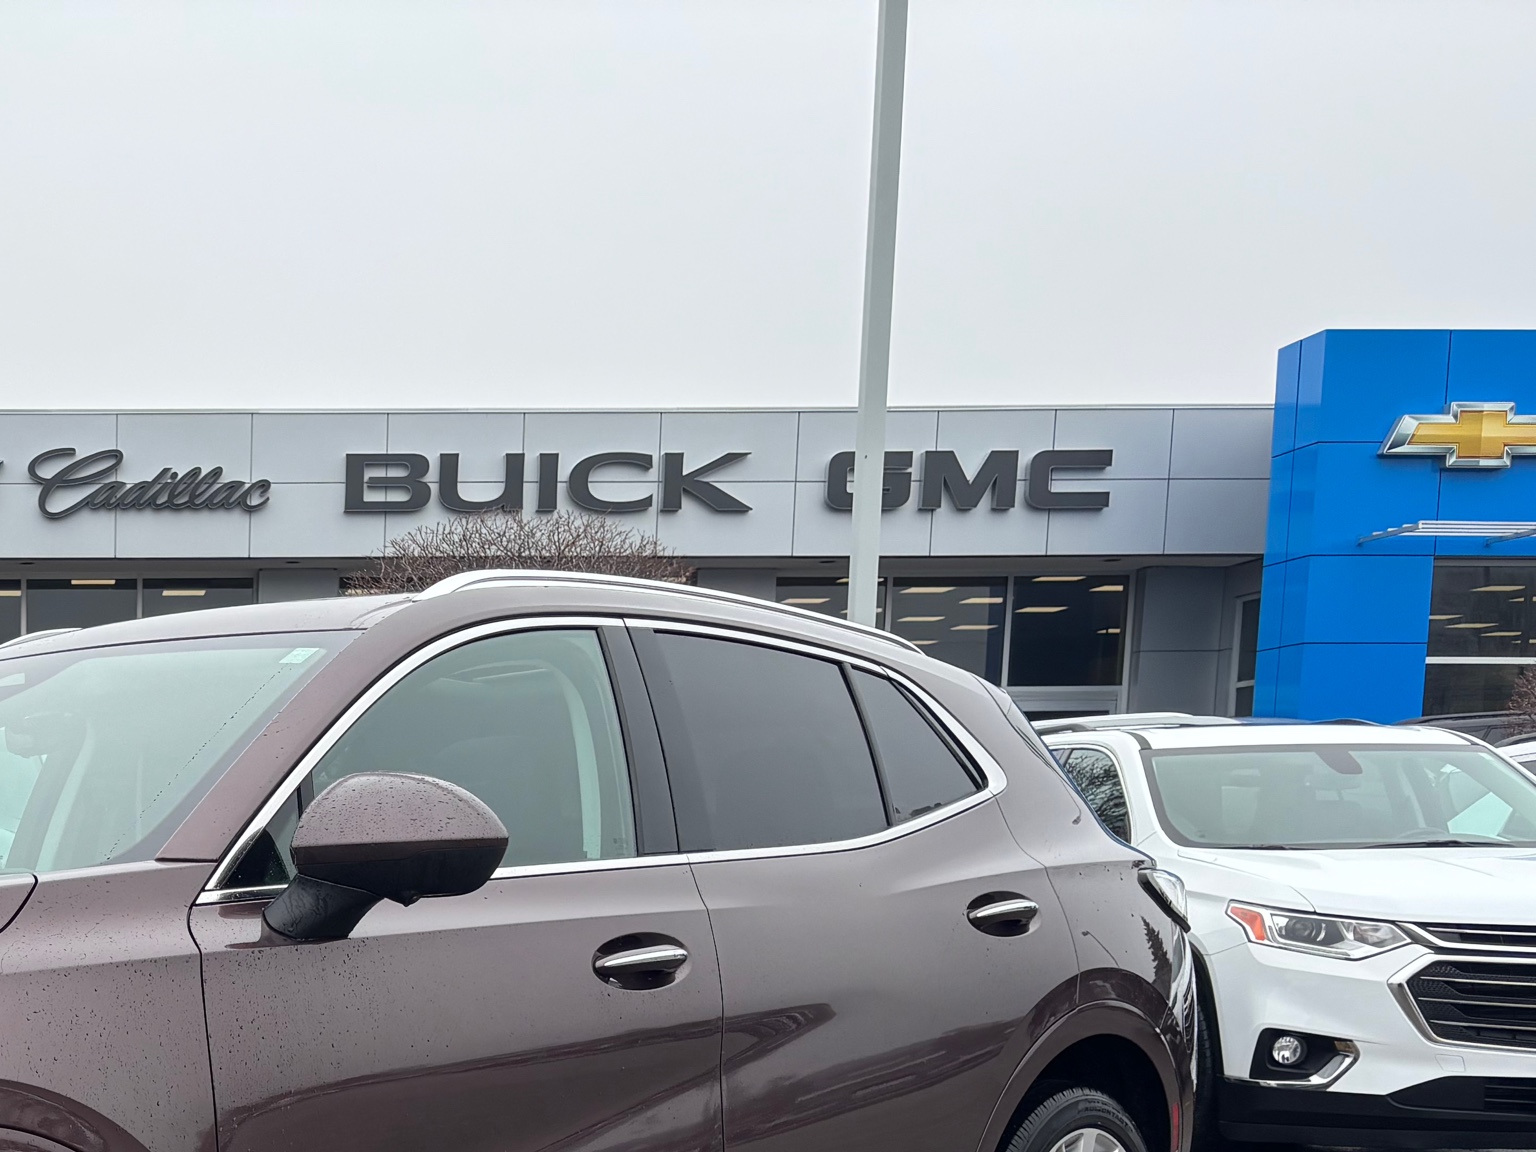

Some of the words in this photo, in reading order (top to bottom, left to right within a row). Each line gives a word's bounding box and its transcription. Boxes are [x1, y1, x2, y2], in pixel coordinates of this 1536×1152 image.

[26, 446, 271, 520] Cadillac
[343, 451, 753, 513] BUICK
[825, 448, 1115, 511] GMC
